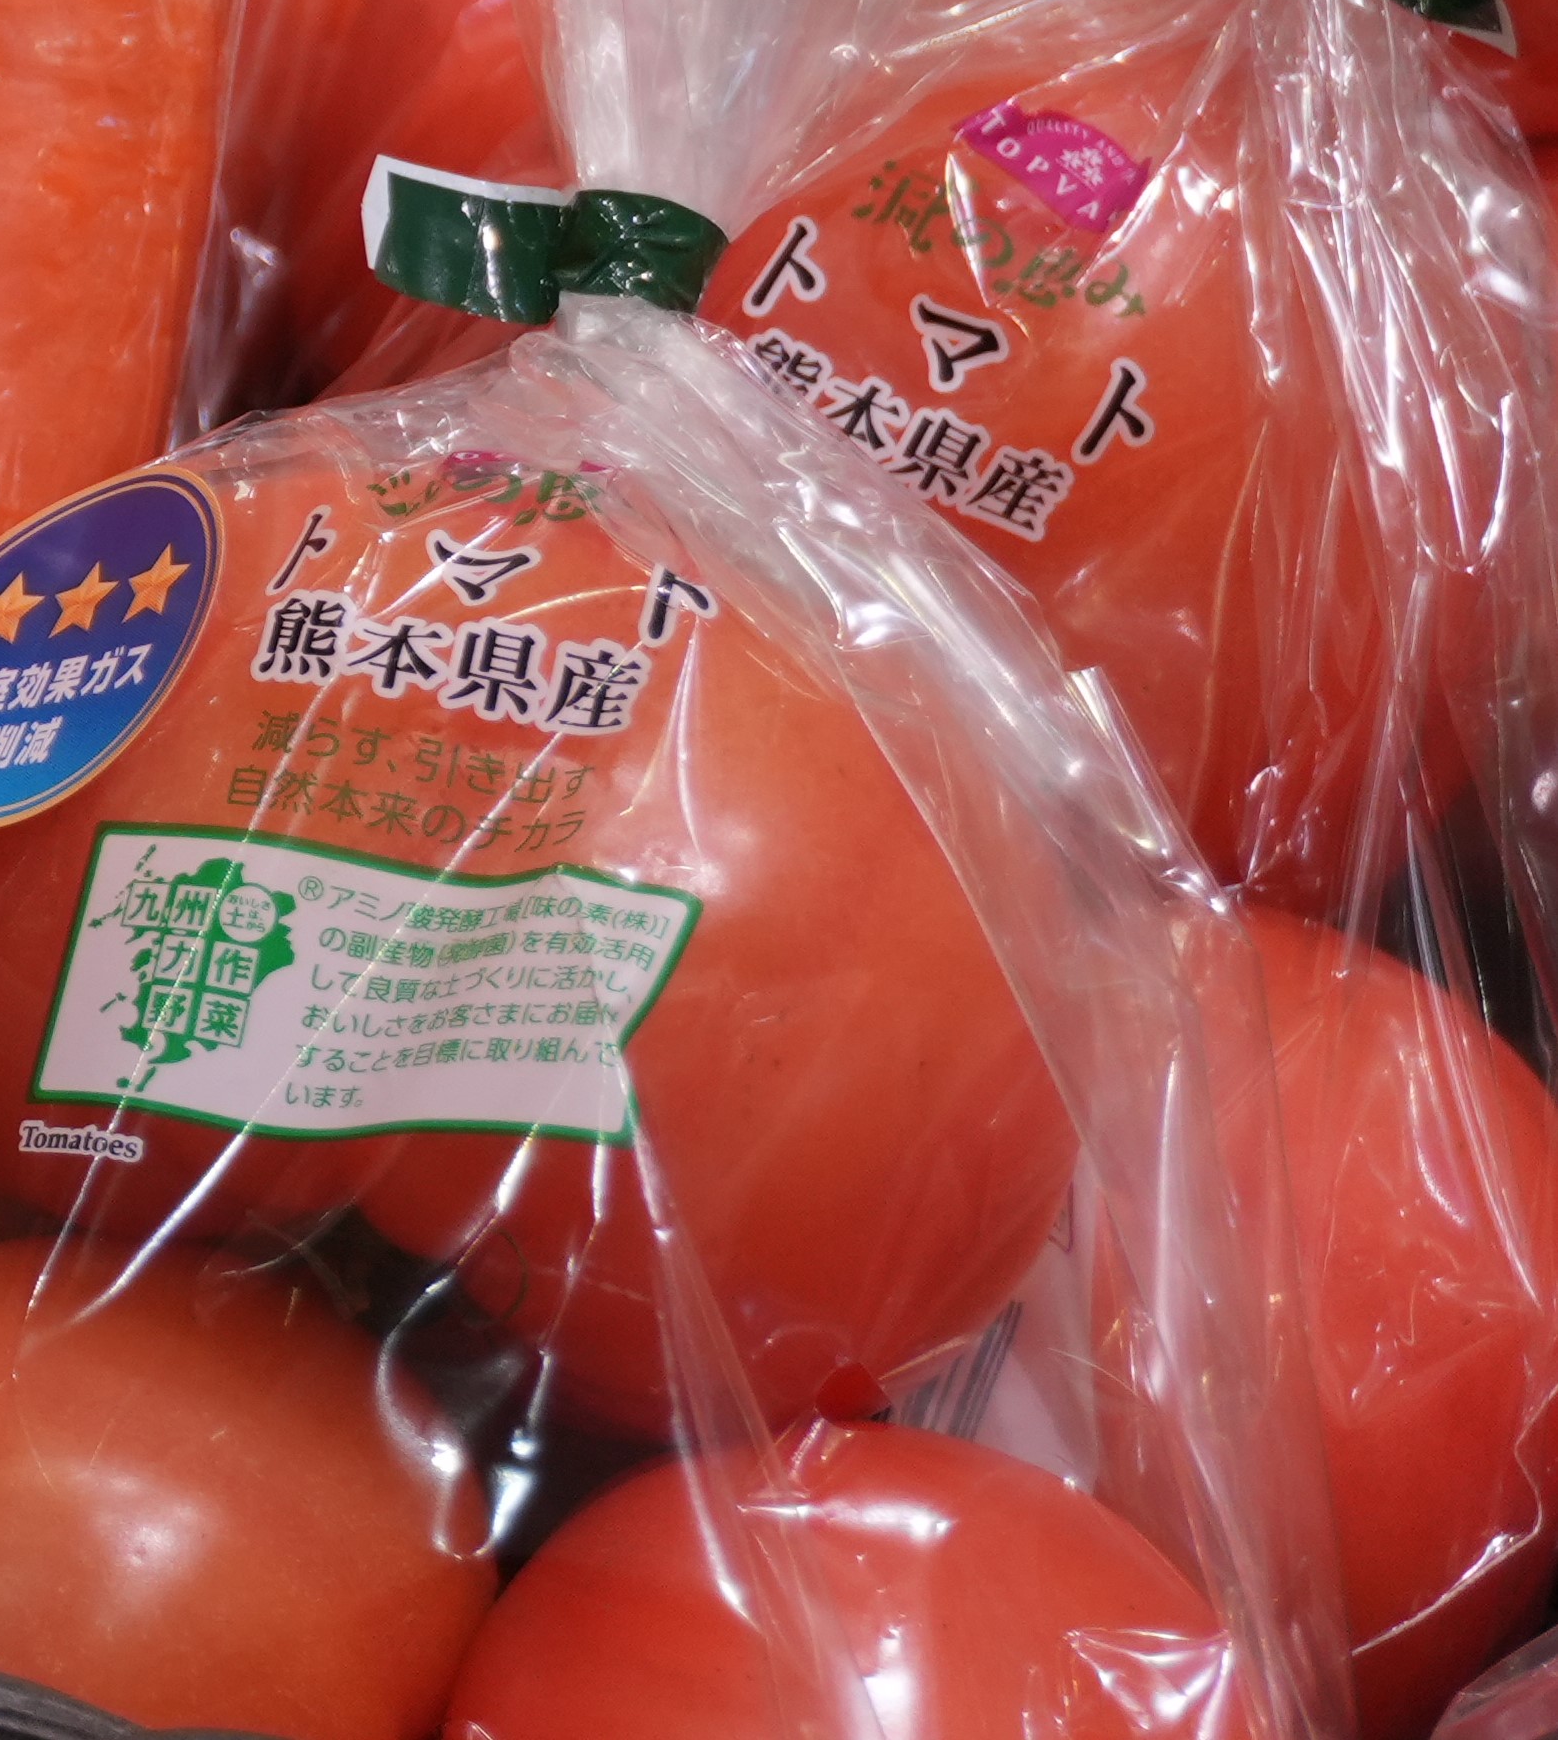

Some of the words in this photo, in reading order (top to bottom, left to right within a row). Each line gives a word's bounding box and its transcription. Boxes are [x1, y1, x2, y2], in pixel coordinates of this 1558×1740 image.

[748, 220, 1147, 459] トマト
[270, 510, 714, 642] トマト
[257, 595, 644, 730] 熊本県産
[251, 709, 596, 805] 減らす、引き出す
[226, 763, 588, 853] 自然本来のチカラ
[22, 1125, 138, 1159] Tomatoes
[284, 1081, 364, 1109] います。
